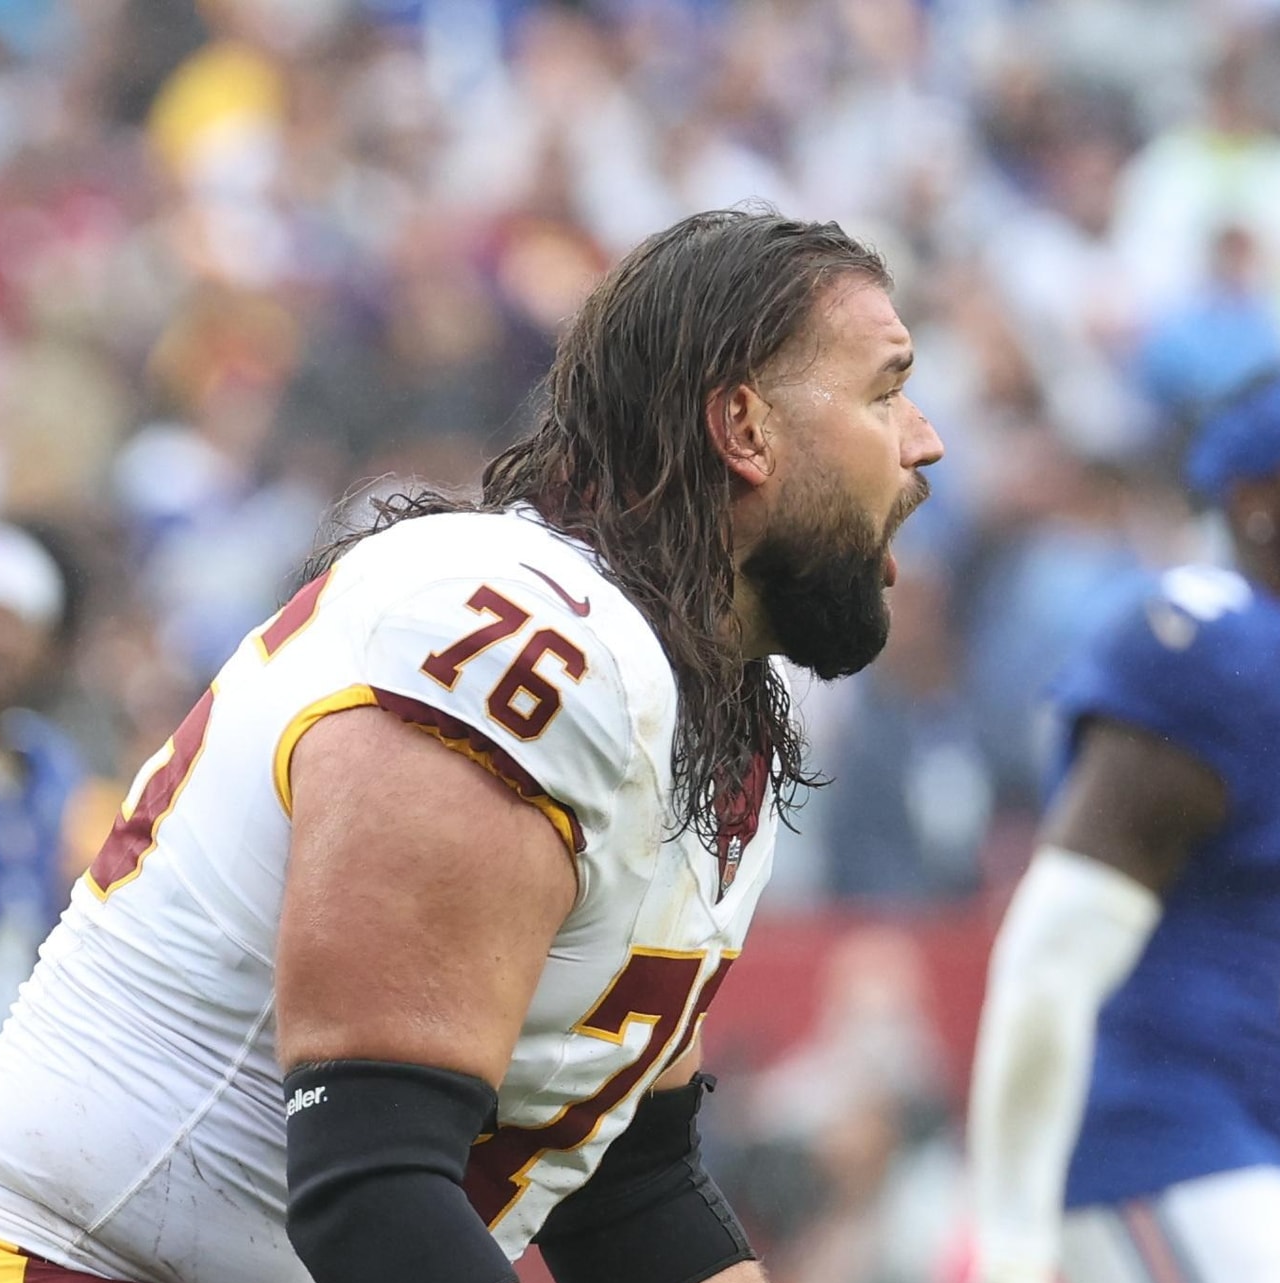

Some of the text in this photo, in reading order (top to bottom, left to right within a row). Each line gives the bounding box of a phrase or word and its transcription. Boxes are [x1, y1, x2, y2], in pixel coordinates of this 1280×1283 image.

[419, 582, 589, 742] 76
[286, 1085, 328, 1119] eller.
[463, 944, 742, 1232] 7
